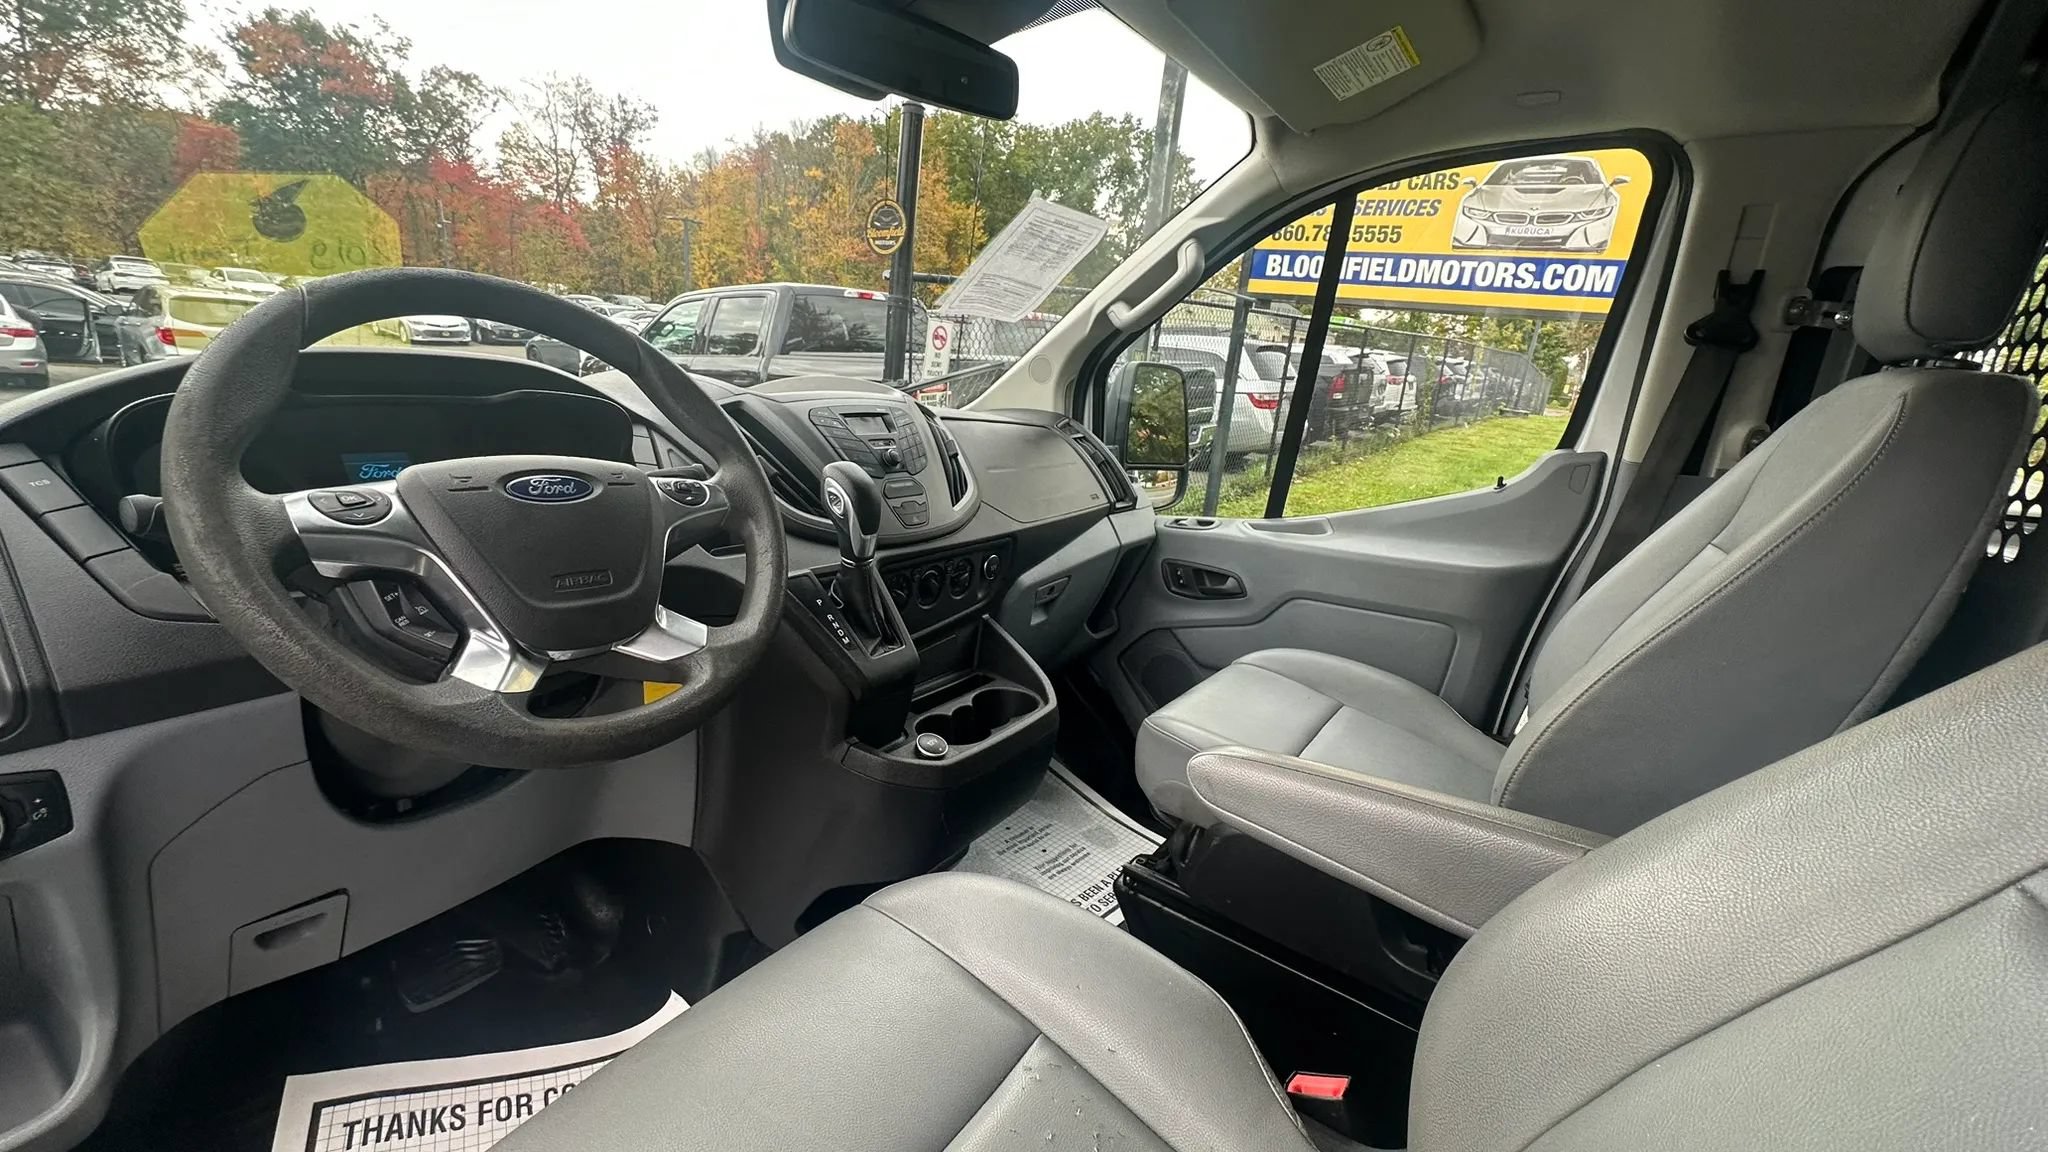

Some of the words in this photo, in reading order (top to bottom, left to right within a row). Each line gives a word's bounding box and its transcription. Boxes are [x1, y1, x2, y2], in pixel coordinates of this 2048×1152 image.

[1408, 172, 1460, 190] CARS
[1354, 199, 1442, 217] SERVICES
[1271, 224, 1403, 243] 860.785555
[1265, 254, 1619, 293] BLOOFIELDMOTORS.COM
[360, 464, 402, 479] Ford
[528, 478, 577, 495] Ford
[1078, 884, 1104, 902] BEEN
[1100, 879, 1111, 888] A
[343, 1103, 466, 1150] THANKS
[478, 1093, 534, 1126] FOR
